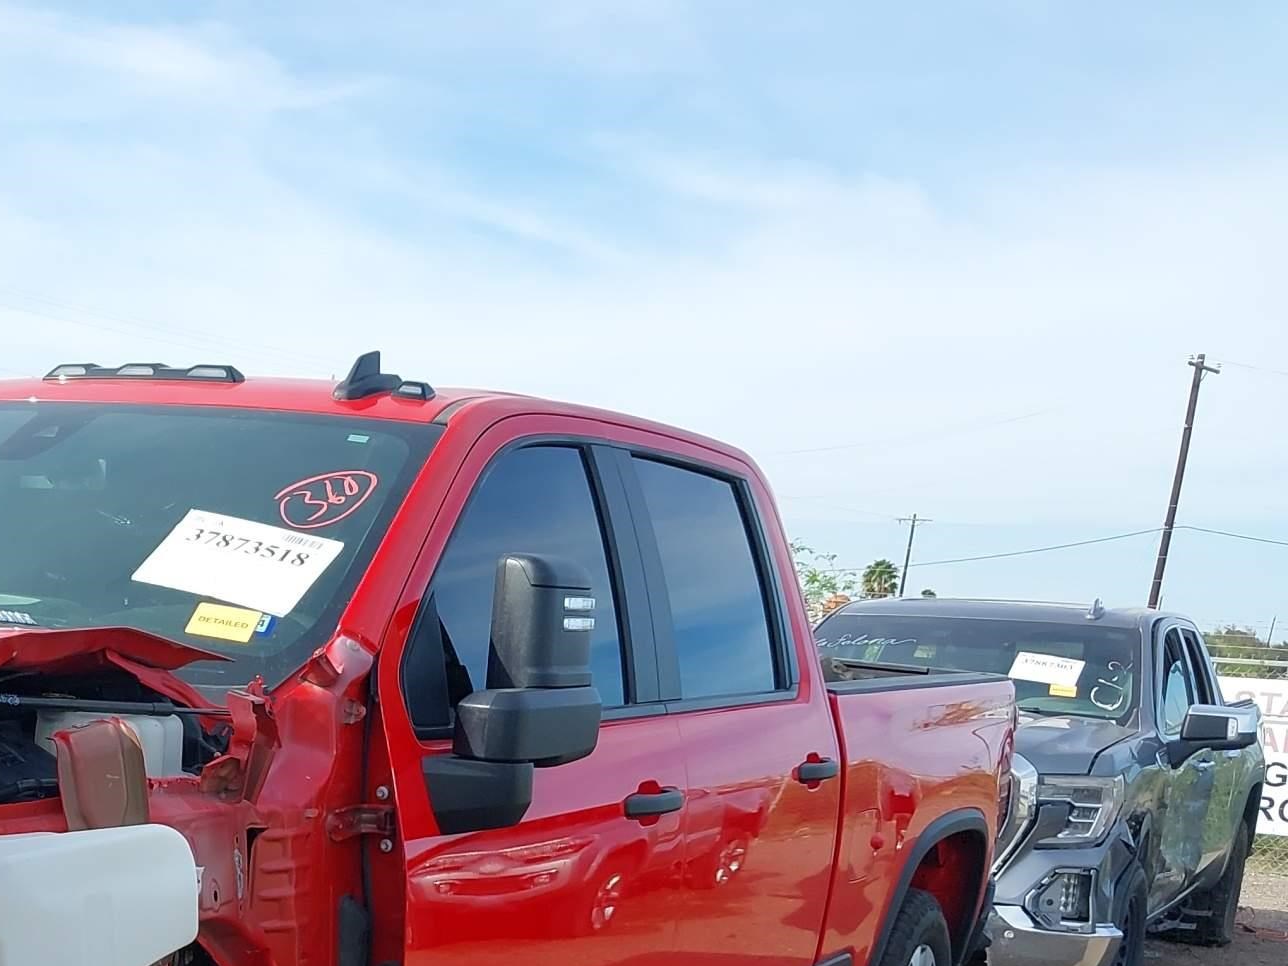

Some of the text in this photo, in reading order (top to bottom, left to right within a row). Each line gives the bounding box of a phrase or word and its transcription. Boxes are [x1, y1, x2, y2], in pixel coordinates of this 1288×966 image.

[293, 474, 360, 521] 360
[186, 528, 311, 567] 37873518
[197, 614, 249, 630] DETAILED
